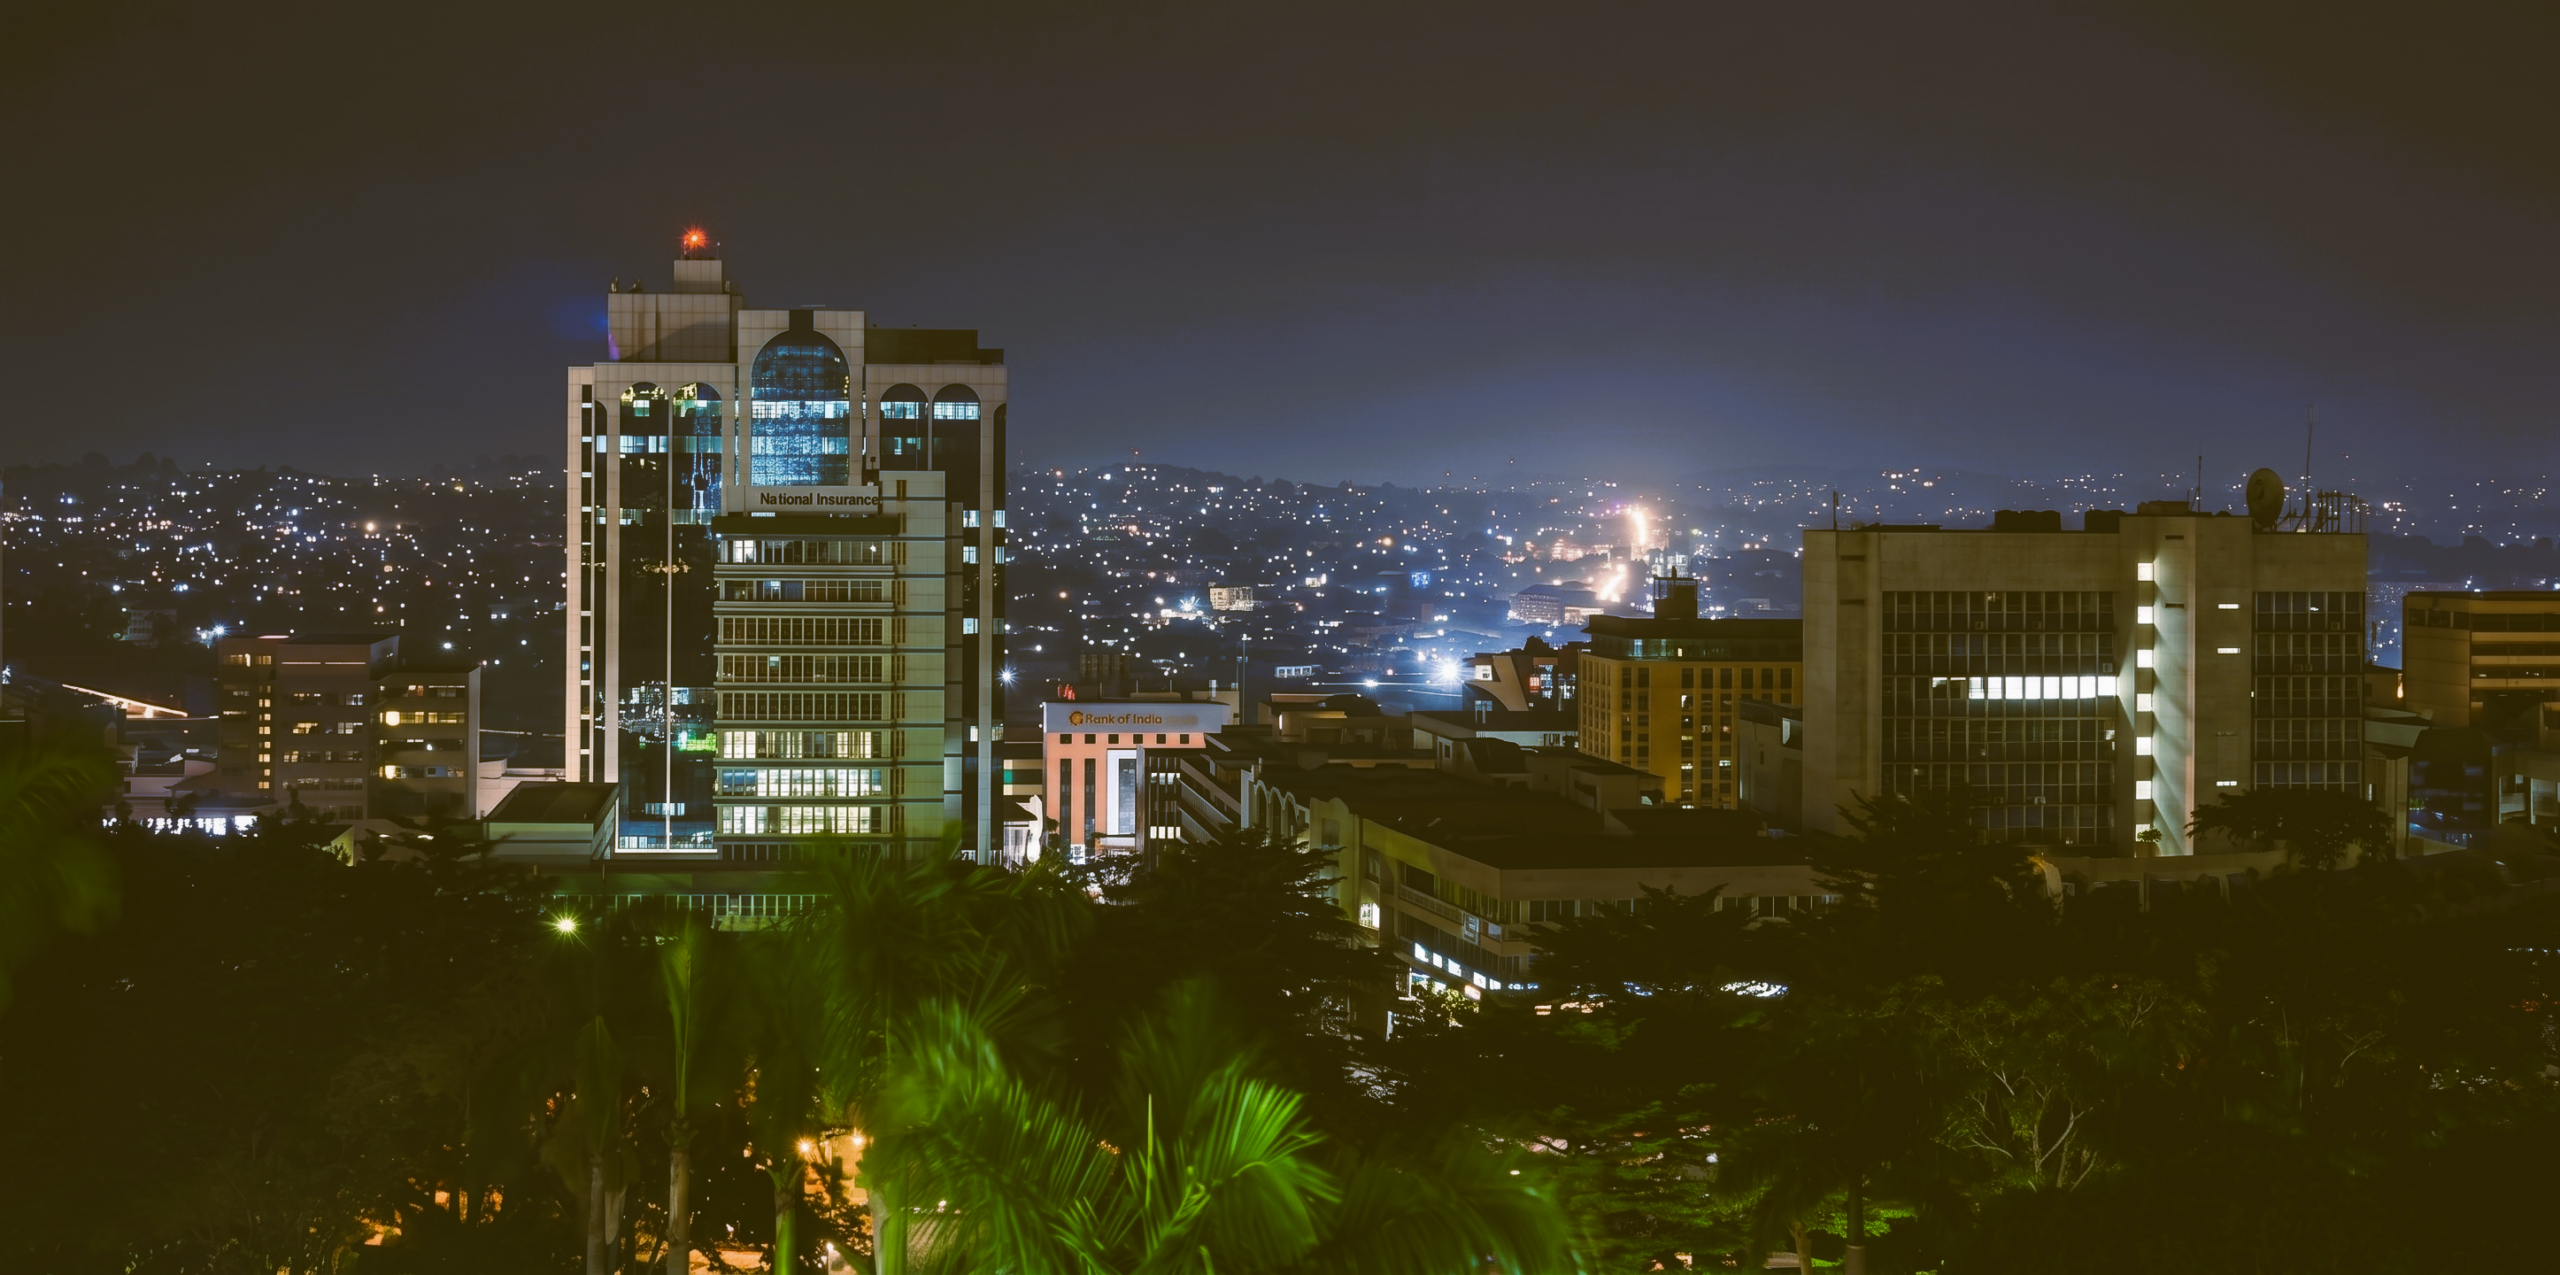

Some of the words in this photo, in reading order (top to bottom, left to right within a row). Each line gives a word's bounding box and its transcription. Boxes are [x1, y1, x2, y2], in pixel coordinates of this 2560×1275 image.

[760, 492, 813, 505] National
[816, 492, 879, 506] Insurance
[1117, 713, 1131, 724] of
[1133, 713, 1162, 724] India
